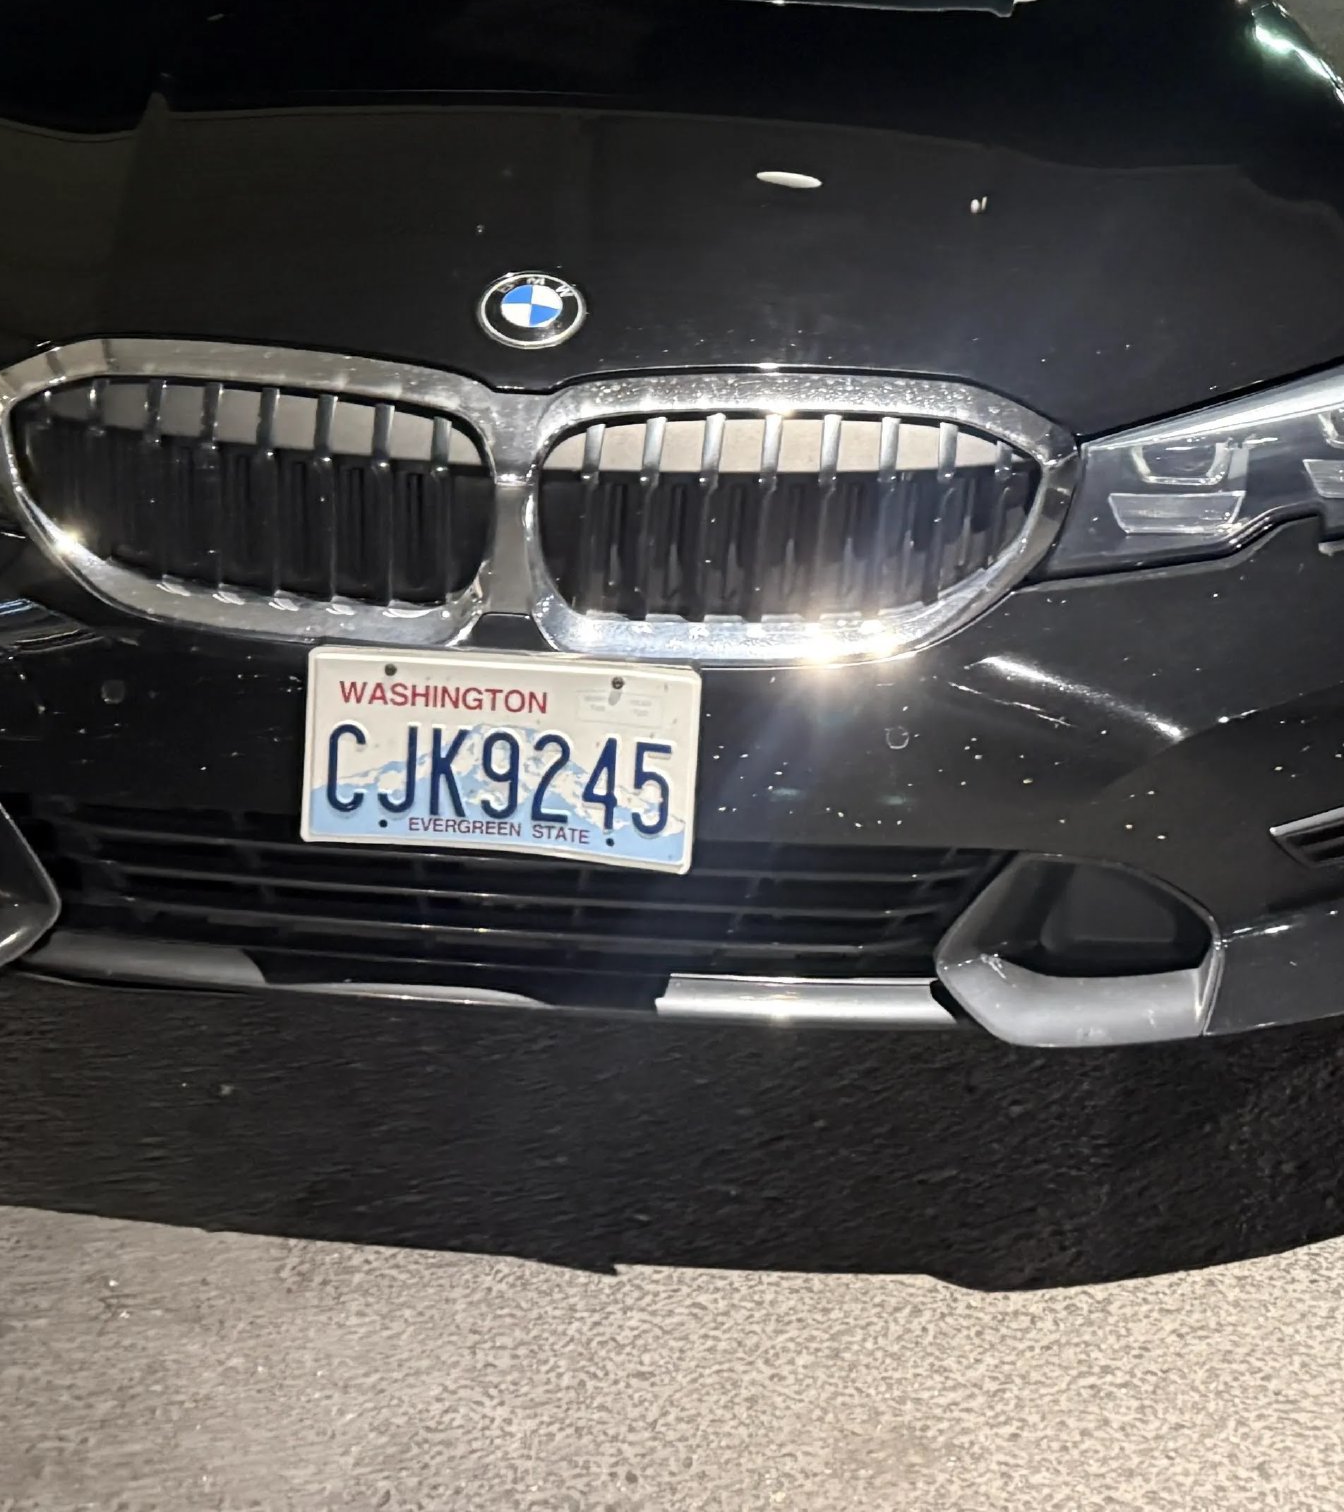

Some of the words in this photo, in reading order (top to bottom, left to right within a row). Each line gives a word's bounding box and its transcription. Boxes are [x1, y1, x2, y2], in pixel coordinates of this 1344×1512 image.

[340, 681, 548, 714] WASHINGTON
[327, 724, 672, 835] CJK9245
[408, 817, 522, 837] EVERGREEN
[532, 824, 591, 844] STATE
